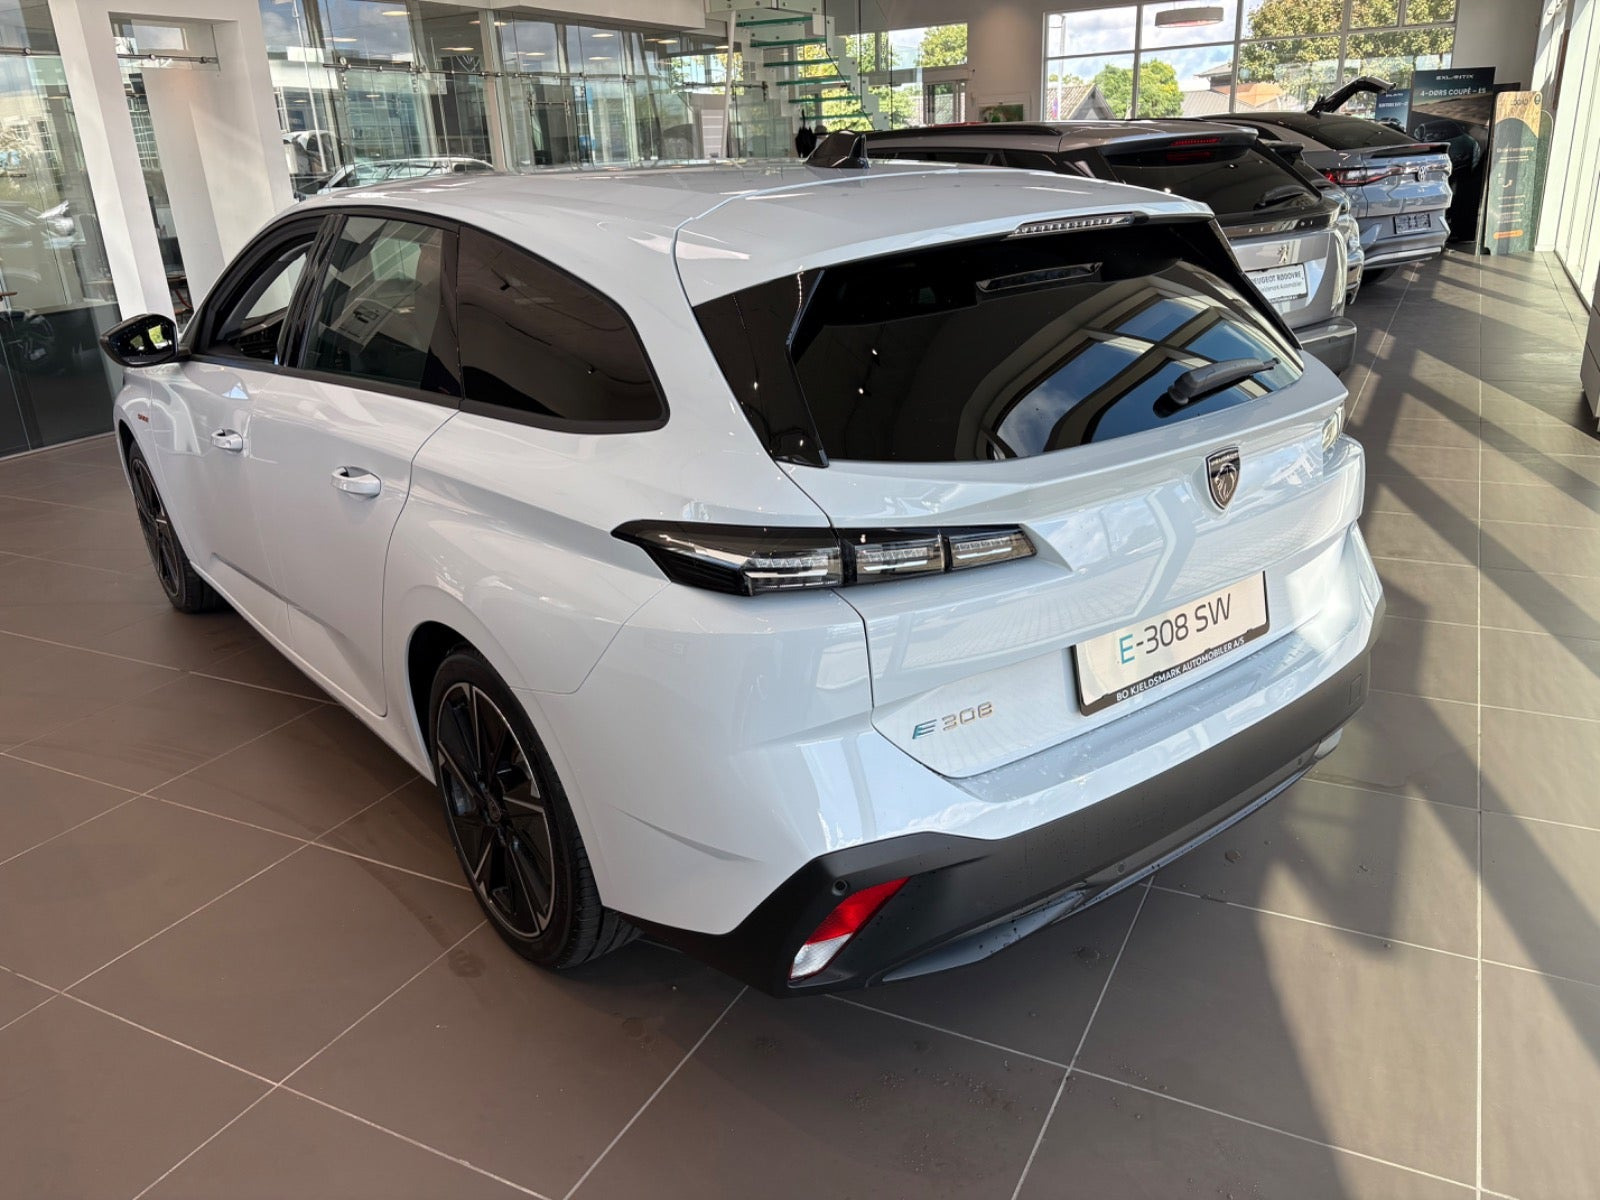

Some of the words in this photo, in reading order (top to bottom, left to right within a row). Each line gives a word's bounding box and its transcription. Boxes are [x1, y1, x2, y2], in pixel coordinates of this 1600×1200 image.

[1448, 87, 1472, 96] COUPÉ
[1119, 612, 1189, 664] E-308
[1194, 592, 1231, 632] SW
[1116, 689, 1129, 701] BO
[1130, 665, 1182, 696] KJELDSMARK
[1182, 642, 1233, 673] AUTOMOBILER
[1233, 636, 1246, 649] A/S
